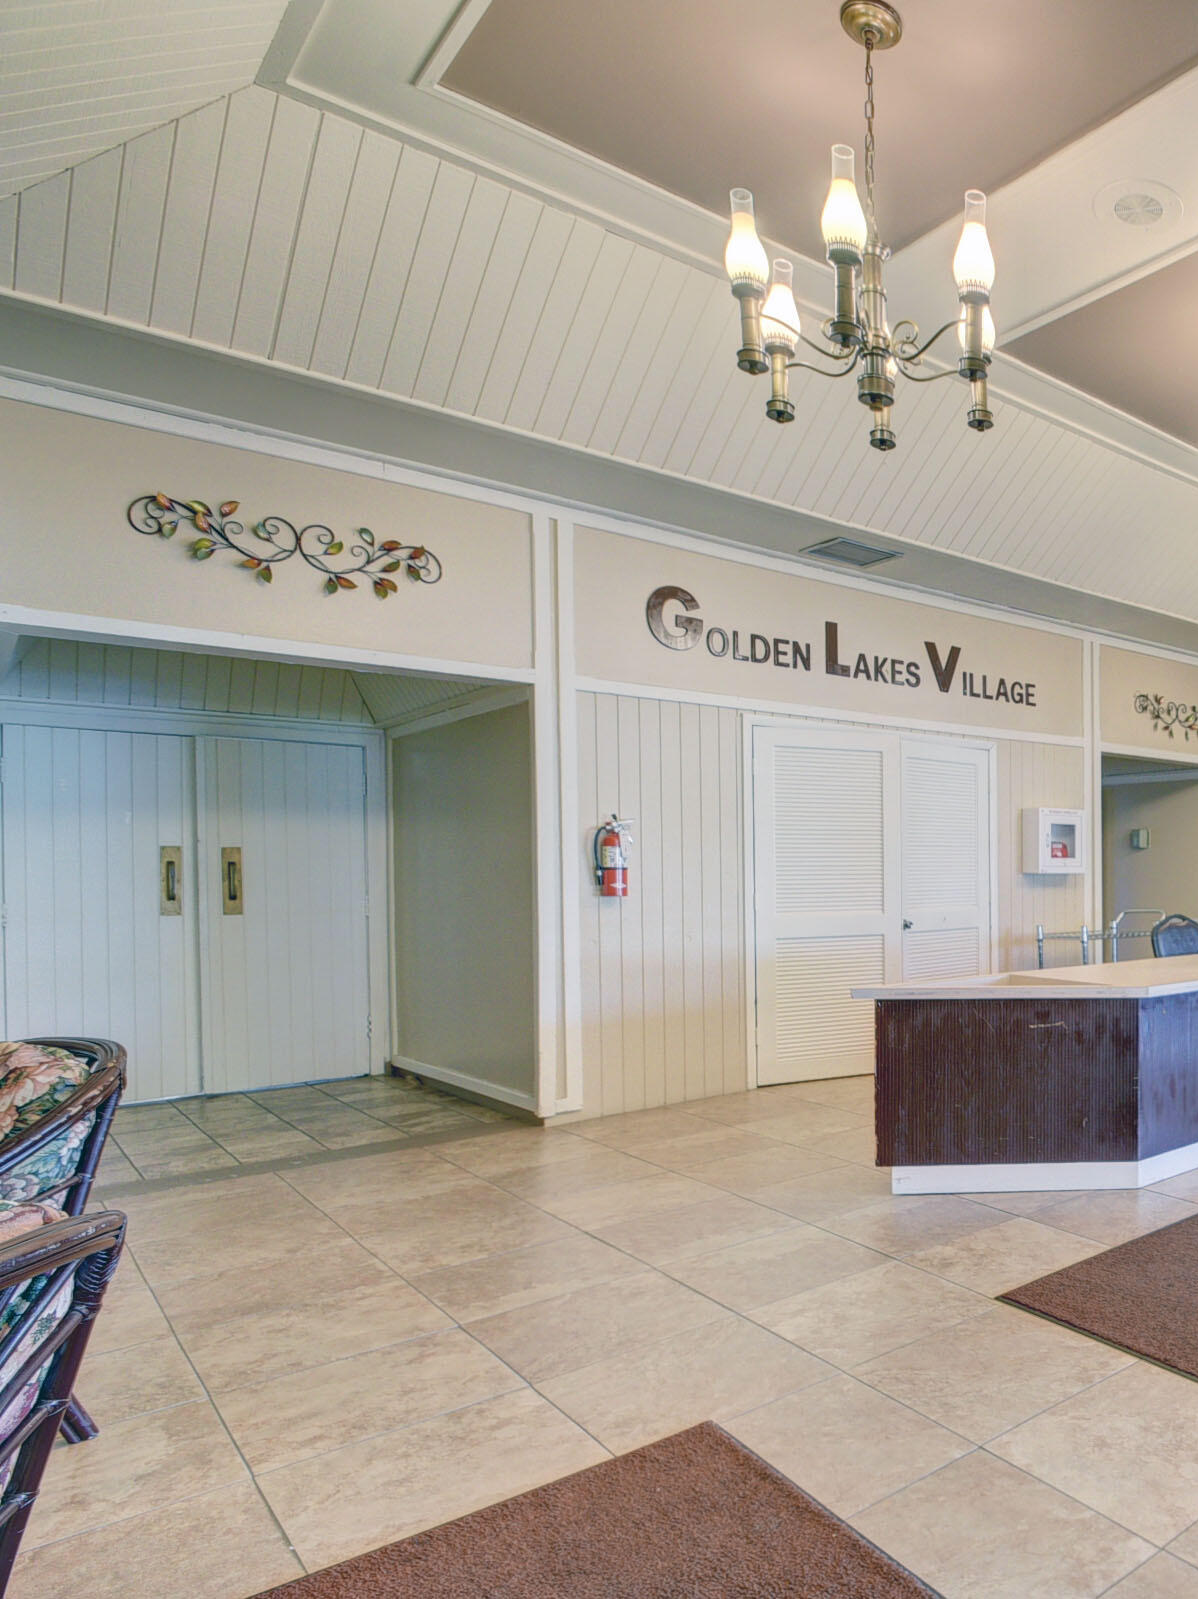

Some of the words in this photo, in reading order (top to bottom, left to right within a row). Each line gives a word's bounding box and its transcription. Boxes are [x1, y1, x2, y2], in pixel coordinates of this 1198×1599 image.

[645, 585, 812, 672] GOLDEN
[824, 621, 921, 688] LAKES
[924, 641, 1037, 708] VILLAGE
